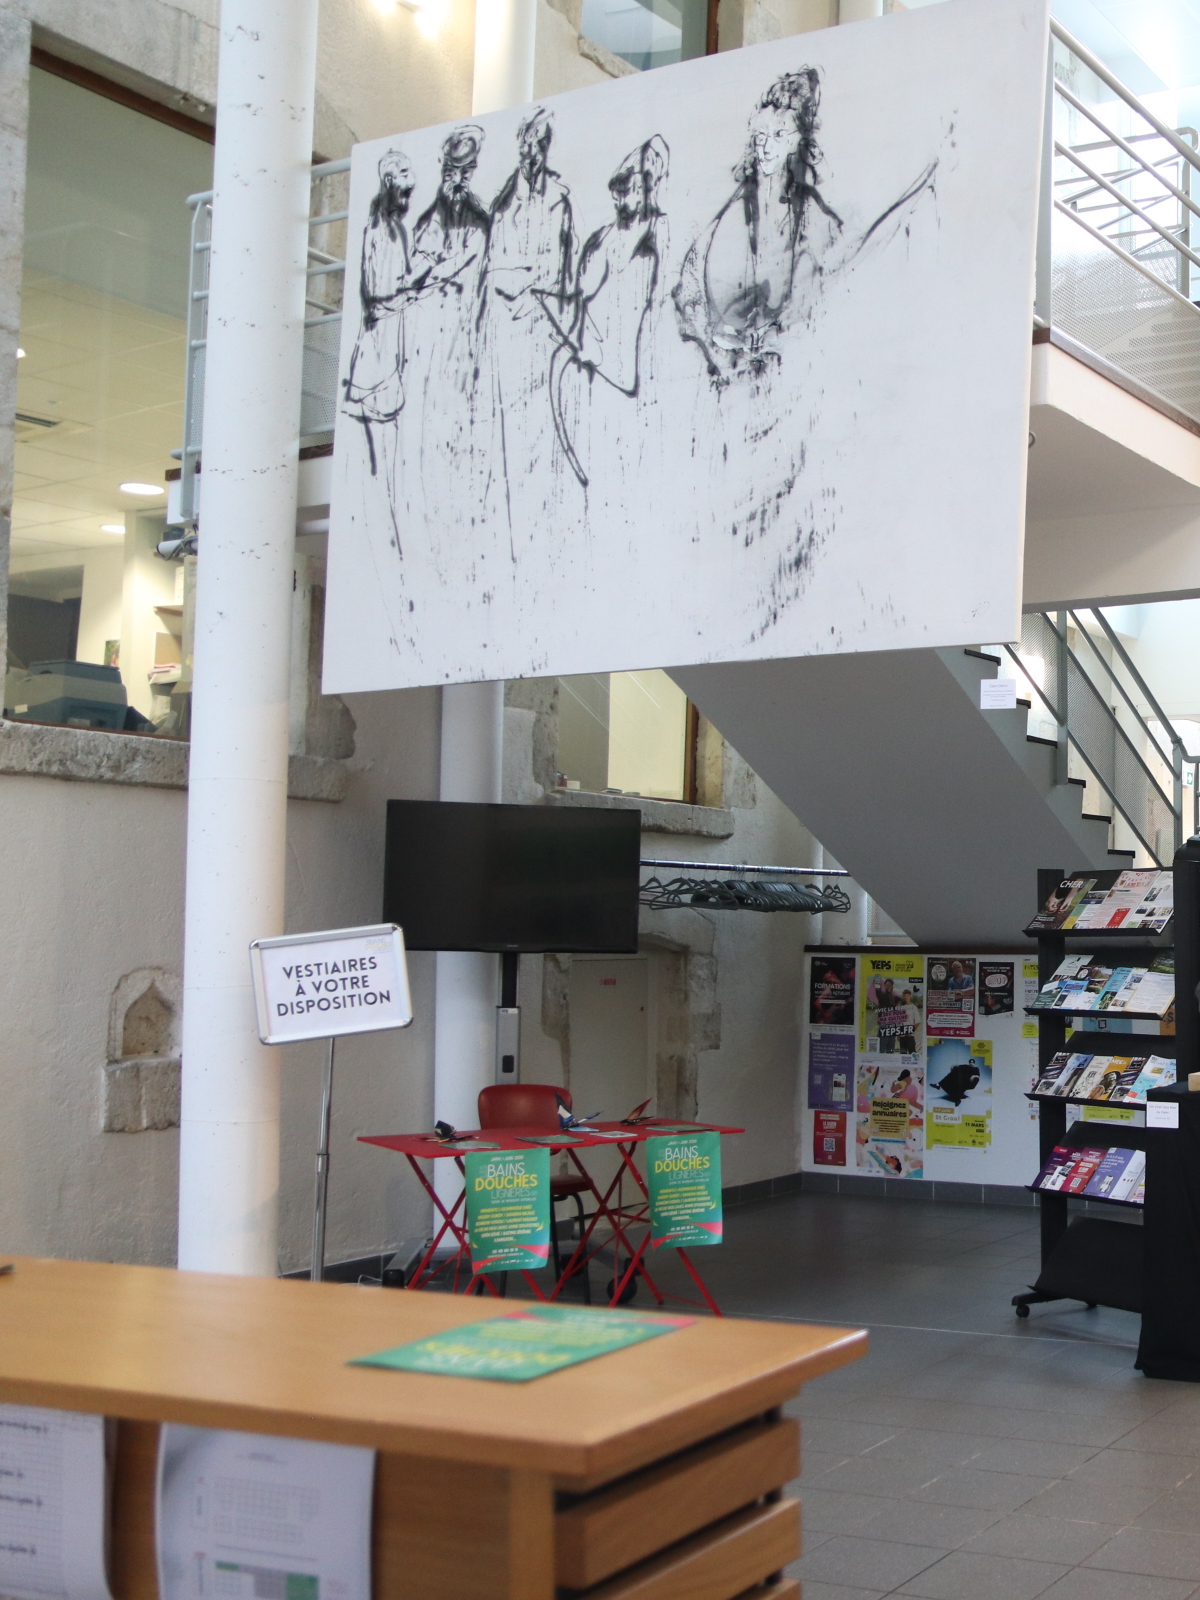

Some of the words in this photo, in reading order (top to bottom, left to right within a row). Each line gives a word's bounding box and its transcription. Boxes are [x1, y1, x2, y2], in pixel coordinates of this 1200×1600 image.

[1060, 880, 1084, 888] CHER
[282, 956, 378, 979] VESTIAIRES
[870, 960, 892, 970] YEPS
[295, 979, 307, 996] À
[312, 975, 370, 994] VOTRE
[277, 990, 391, 1017] DISPOSITION
[880, 1026, 914, 1037] YEPS.FR
[872, 1101, 907, 1109] Rejoignez
[872, 1110, 907, 1118] annuaires
[665, 1145, 699, 1161] BAINS
[487, 1162, 525, 1178] BAINS
[655, 1156, 710, 1173] DOUCHES
[475, 1174, 538, 1191] DOUCHES
